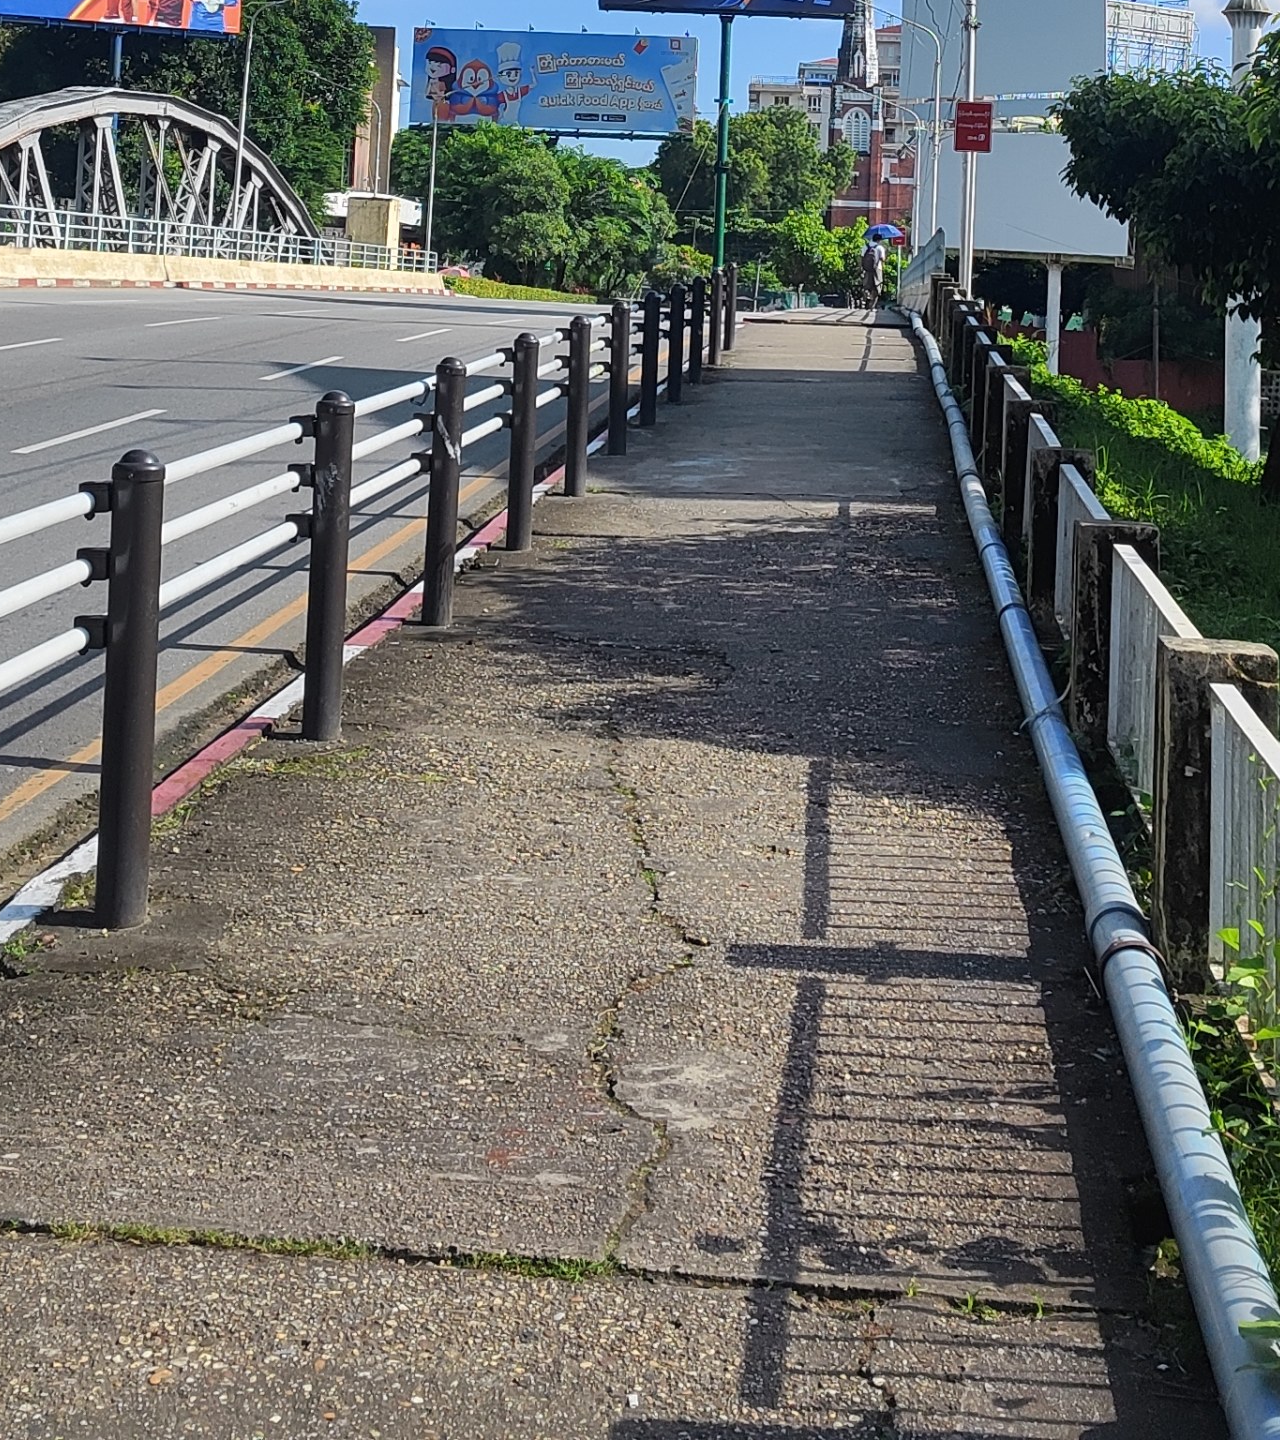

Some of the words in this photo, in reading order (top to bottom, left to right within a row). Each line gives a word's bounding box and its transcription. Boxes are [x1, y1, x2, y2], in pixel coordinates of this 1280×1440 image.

[538, 94, 576, 108] Quick
[577, 94, 609, 106] Food
[609, 96, 636, 111] App
